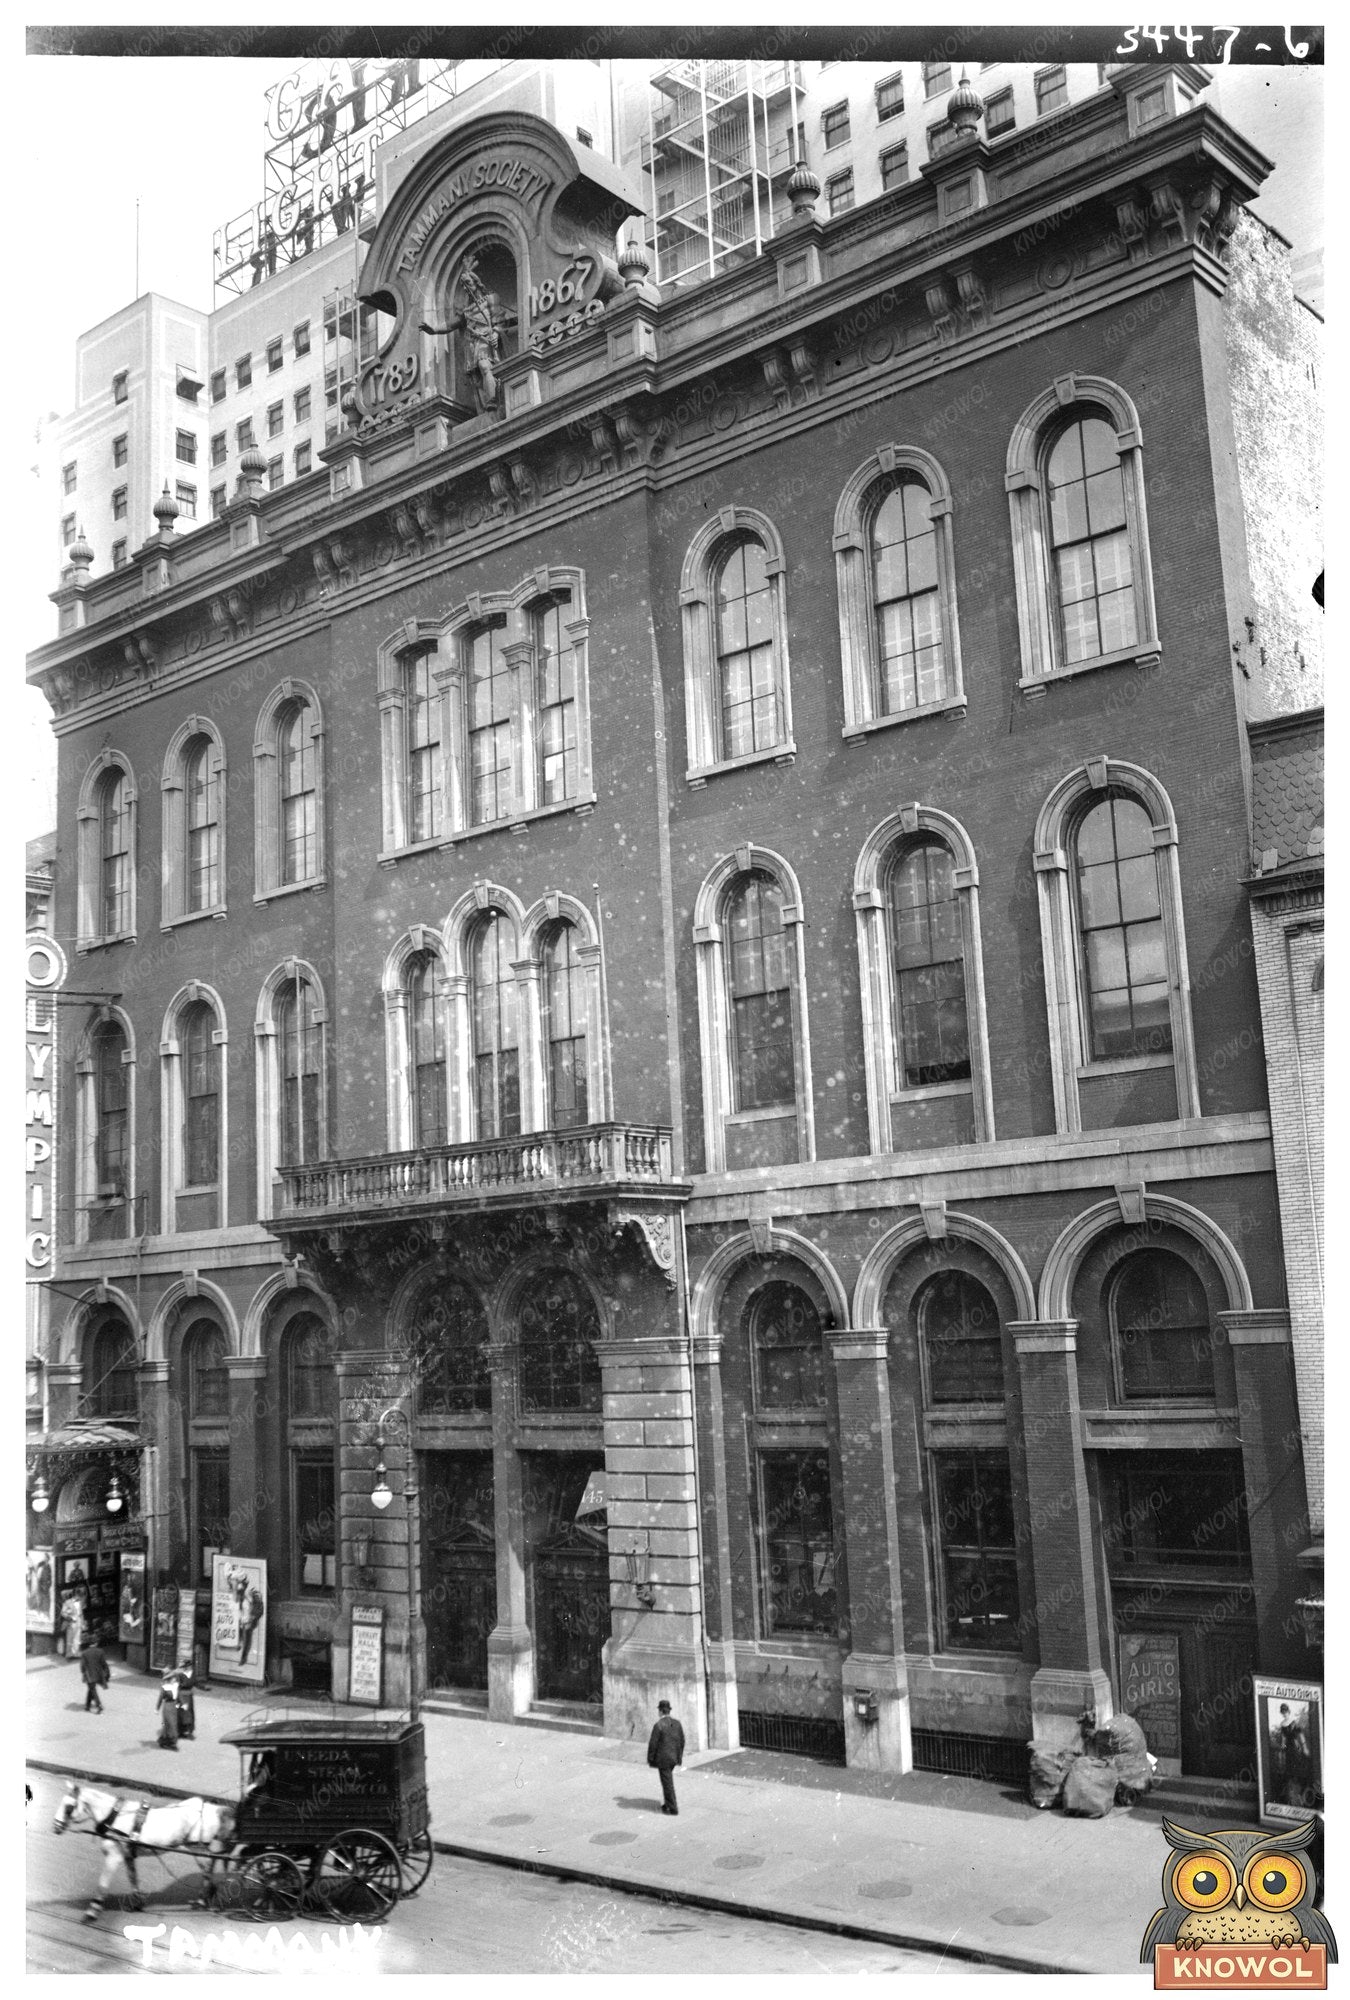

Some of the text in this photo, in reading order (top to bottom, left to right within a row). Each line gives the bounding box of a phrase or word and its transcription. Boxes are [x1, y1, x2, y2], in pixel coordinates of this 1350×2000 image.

[397, 168, 474, 273] TAMMANY
[472, 159, 549, 202] SOCIETY
[531, 260, 593, 318] 1867
[369, 352, 417, 404] 1789
[26, 943, 60, 1268] OLYMPIC
[581, 1490, 604, 1503] 145
[216, 1614, 234, 1625] AUTO
[215, 1628, 236, 1641] GIRLS
[1128, 1661, 1175, 1681] AUTO
[1126, 1680, 1175, 1702] GIRLS
[1276, 1686, 1296, 1697] AUTO
[1297, 1687, 1319, 1700] GIRLS
